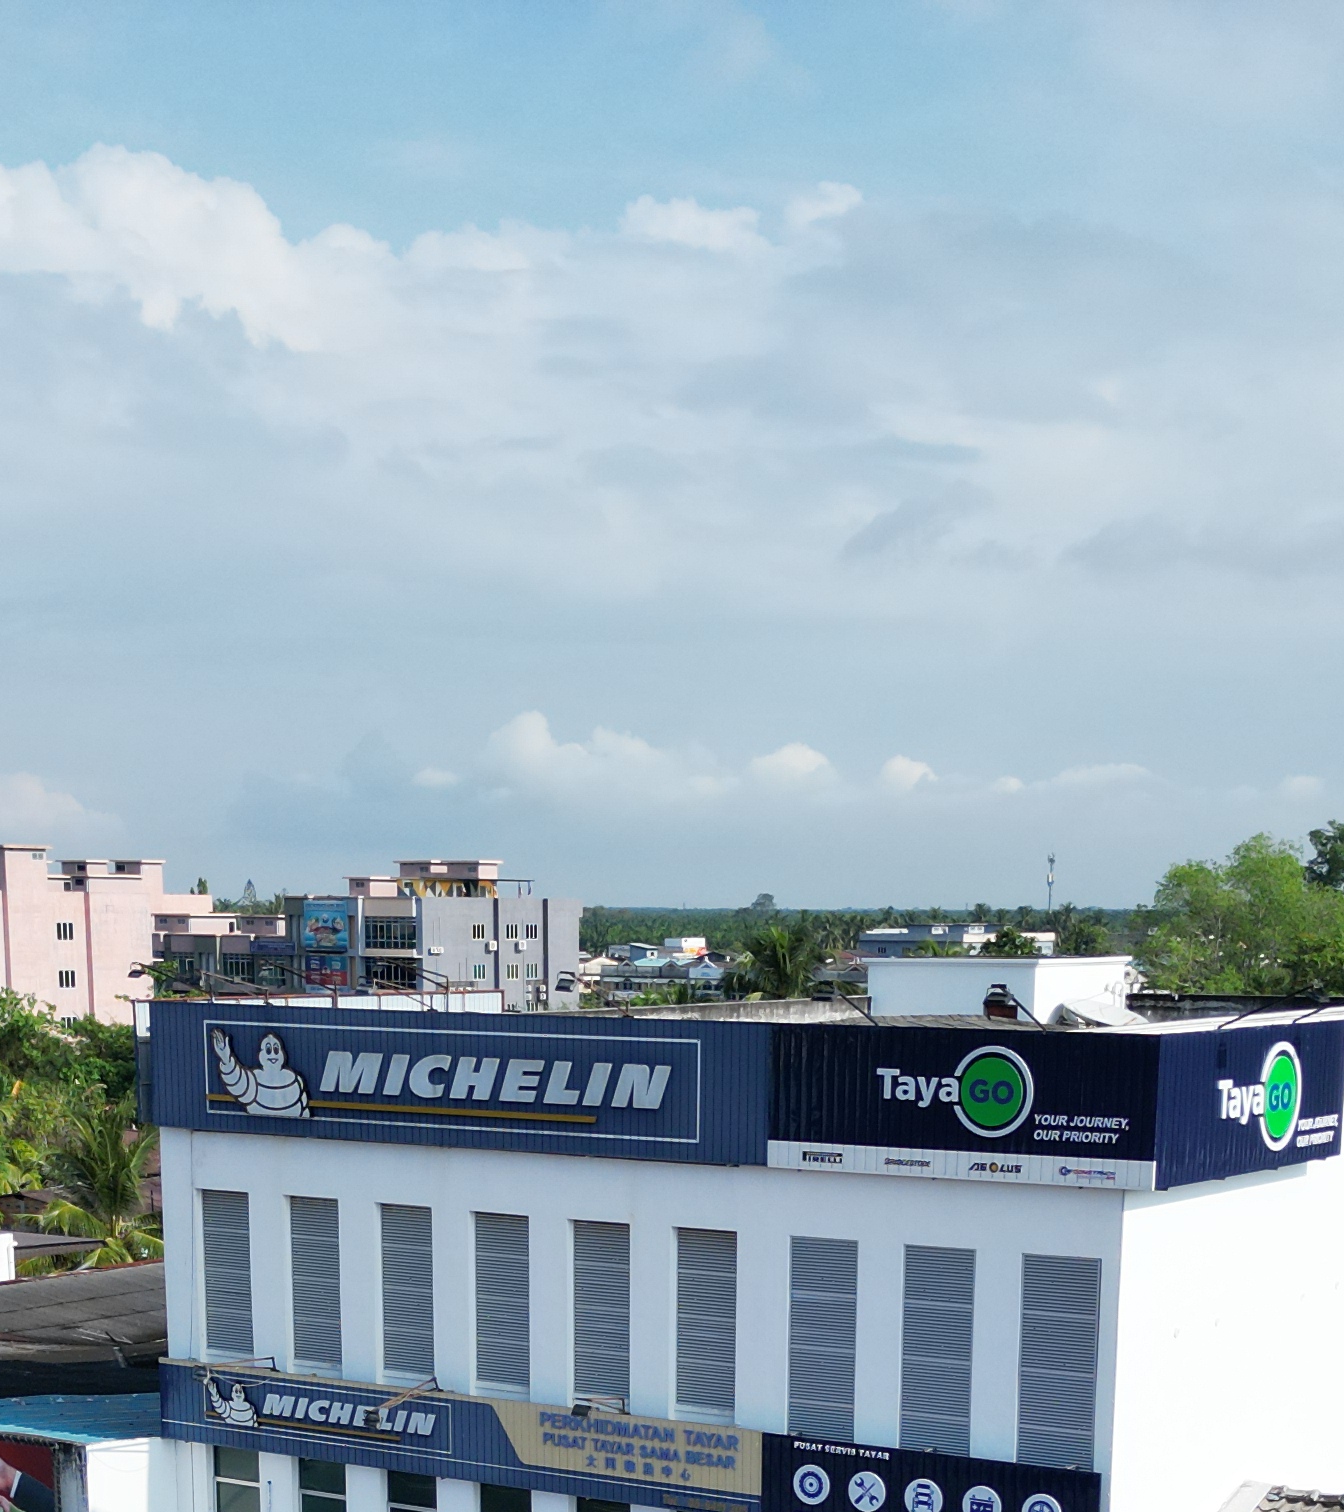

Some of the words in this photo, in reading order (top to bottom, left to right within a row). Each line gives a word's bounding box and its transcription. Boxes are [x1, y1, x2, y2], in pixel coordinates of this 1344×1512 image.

[319, 1050, 672, 1110] MICHELIN
[1033, 1129, 1060, 1142] OUR
[1062, 1131, 1119, 1144] PRIORITY
[1034, 1114, 1067, 1127] YOUR
[1069, 1115, 1129, 1131] JOURNEY,
[262, 1393, 436, 1436] MICHELIN
[539, 1411, 675, 1444] PERKHIDMATAN
[683, 1429, 740, 1451] TAYAR
[543, 1432, 587, 1451] PUSAT
[591, 1438, 635, 1457] TAYAR
[639, 1444, 681, 1463] SAMA
[684, 1451, 736, 1471] BESAR
[794, 1441, 823, 1451] PUSAT
[825, 1445, 856, 1456] SERVIS
[858, 1449, 890, 1460] TAYAR
